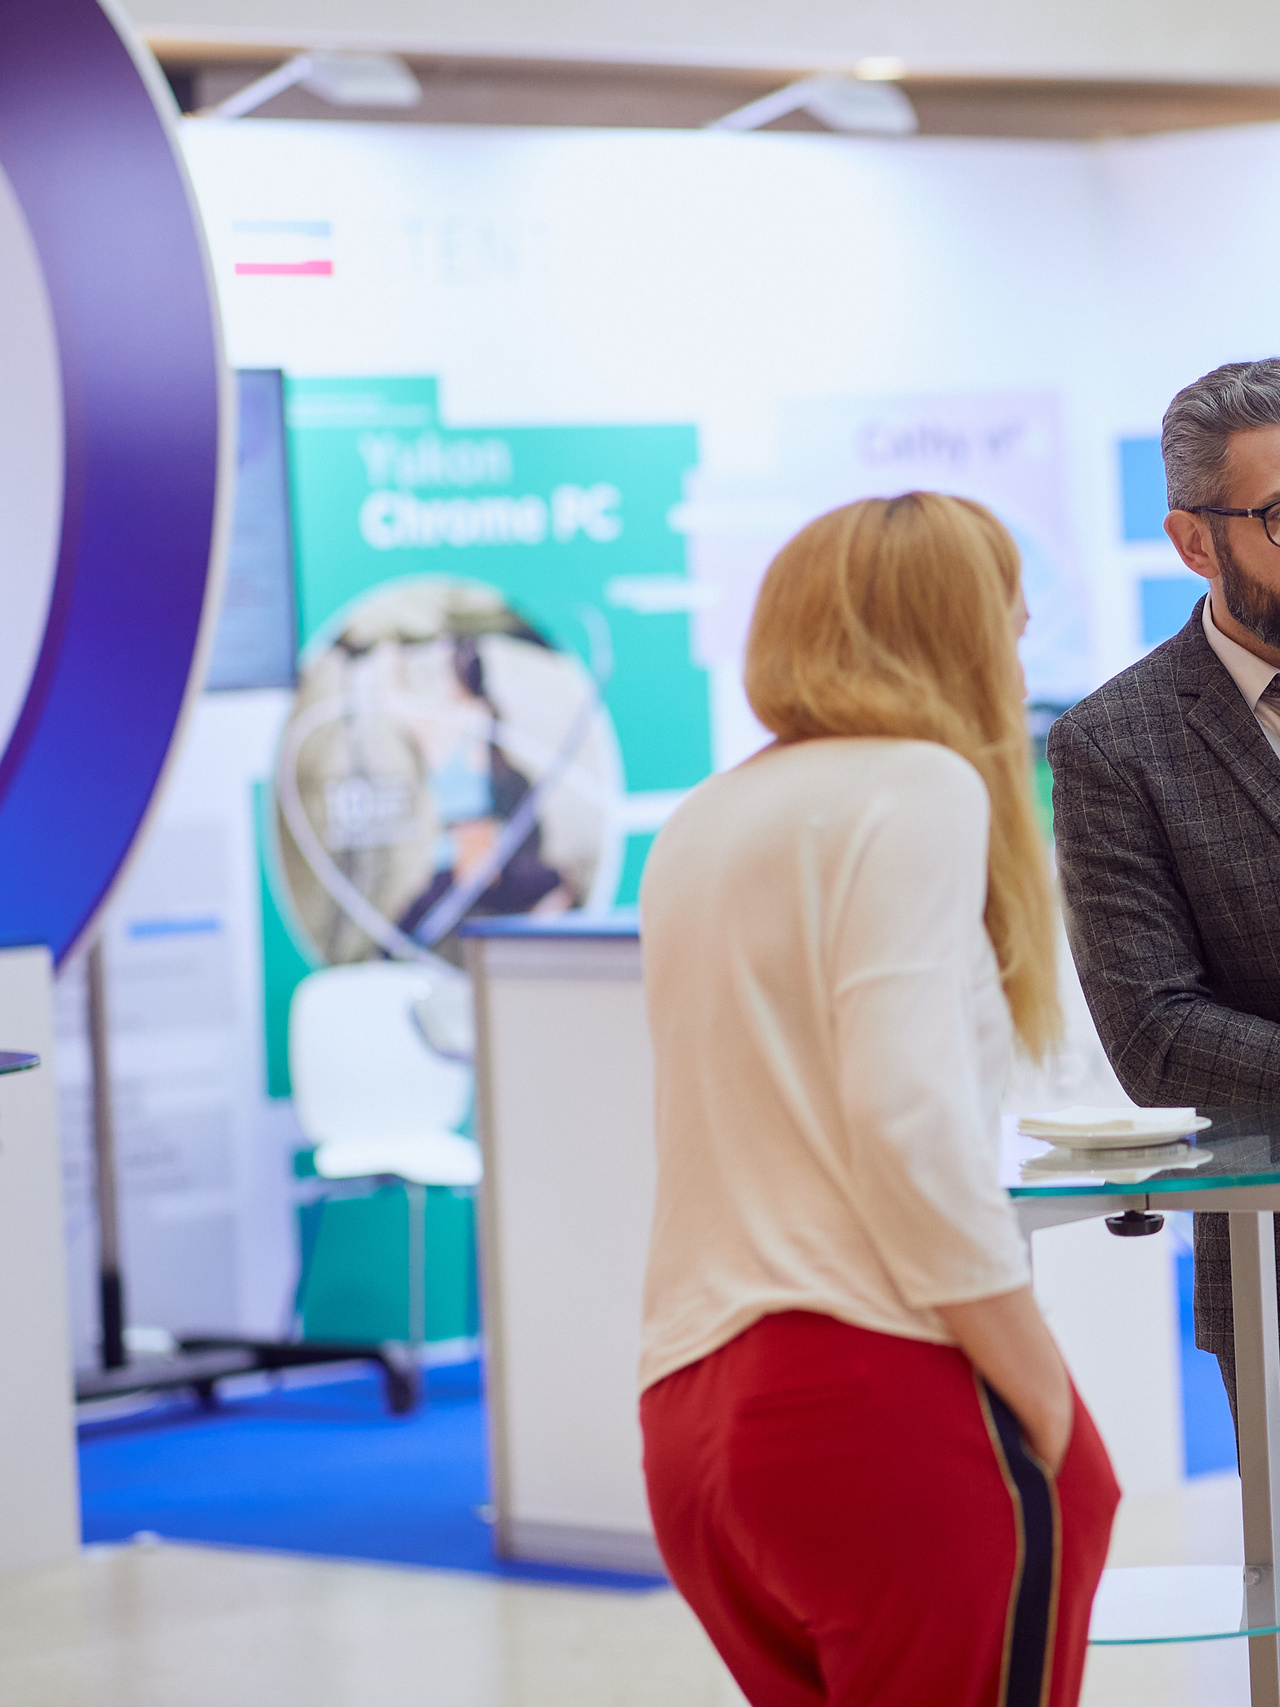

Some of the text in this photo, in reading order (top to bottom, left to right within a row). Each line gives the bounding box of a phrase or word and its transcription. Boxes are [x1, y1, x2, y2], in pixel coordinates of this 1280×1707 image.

[358, 432, 513, 488] Yukon
[360, 483, 622, 549] Chrome PC
